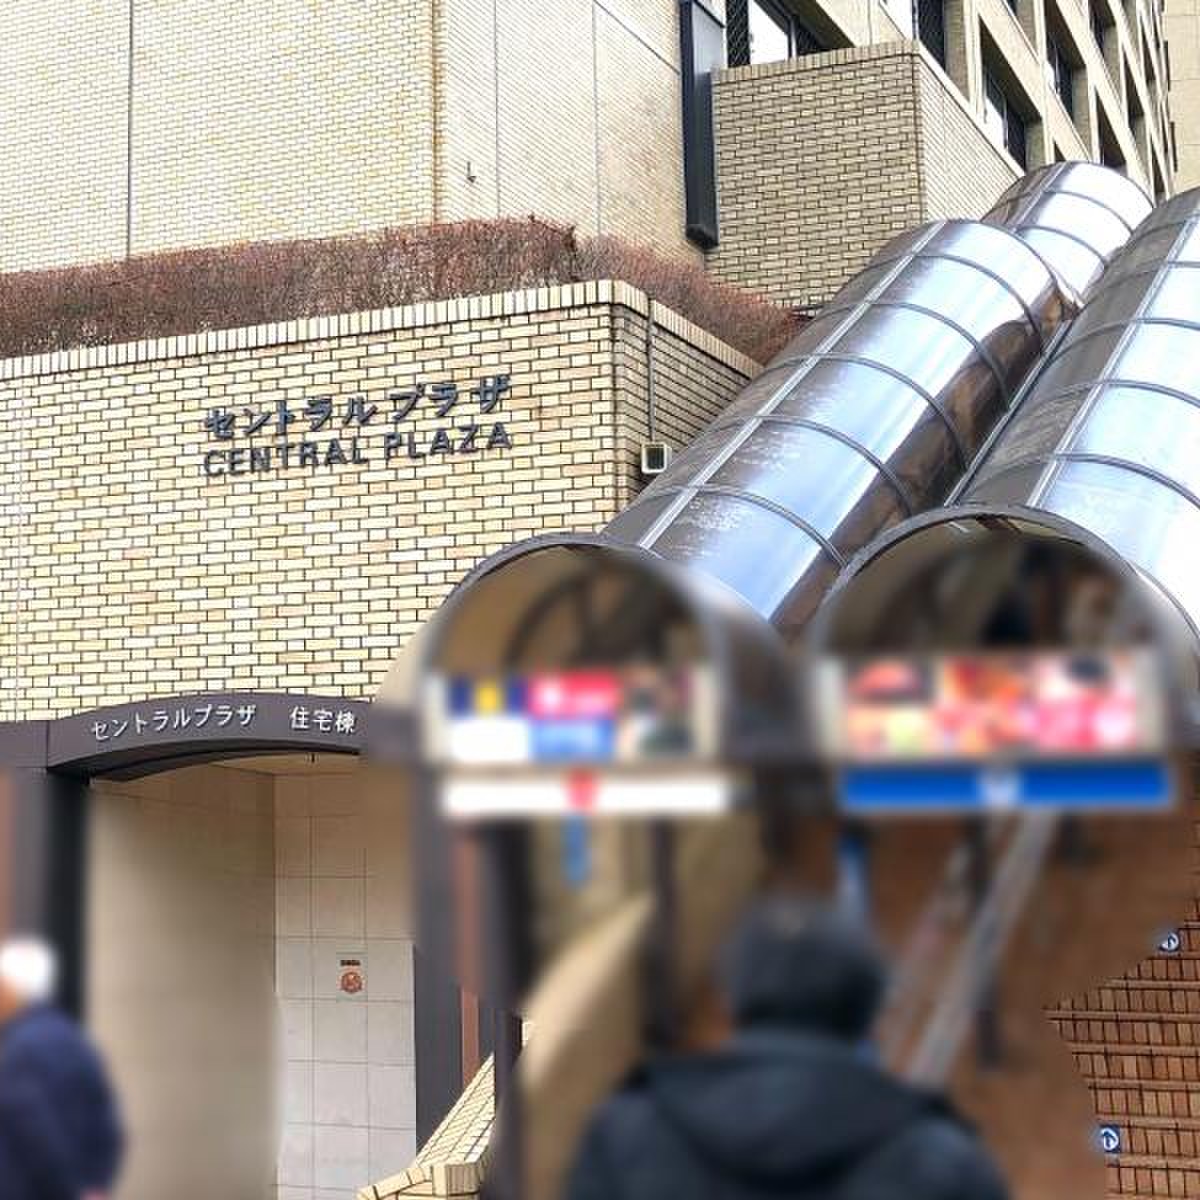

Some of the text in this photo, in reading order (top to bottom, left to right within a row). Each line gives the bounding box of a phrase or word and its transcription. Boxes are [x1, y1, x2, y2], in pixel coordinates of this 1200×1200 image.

[204, 375, 511, 440] セントラルプラザ
[204, 422, 513, 476] CENTRAL PLAZA
[91, 704, 356, 741] セントラルプラザ 住宅棟
